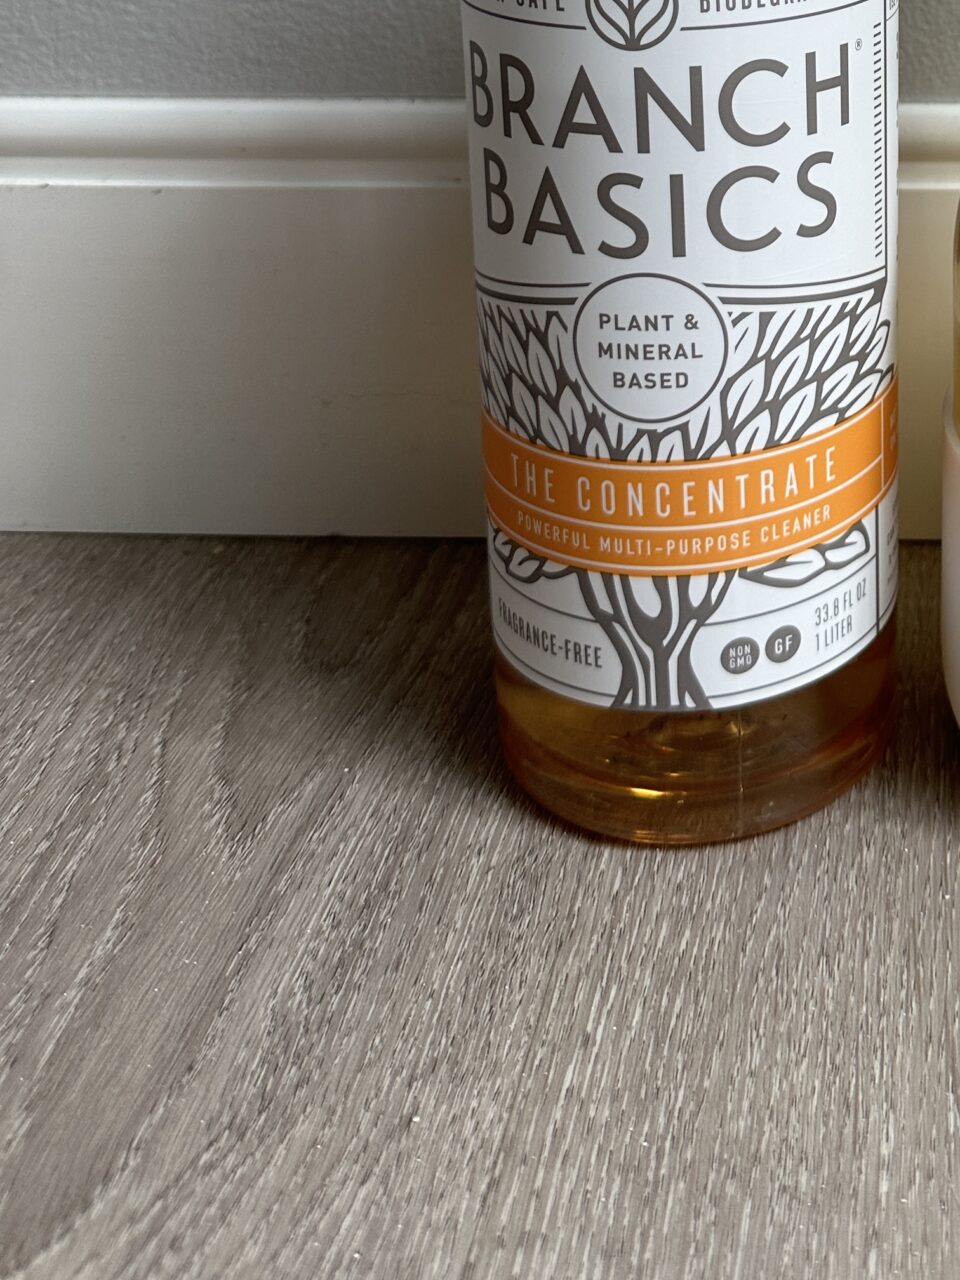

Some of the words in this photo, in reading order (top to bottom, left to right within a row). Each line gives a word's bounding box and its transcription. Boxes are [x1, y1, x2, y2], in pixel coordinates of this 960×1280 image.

[483, 147, 838, 260] BASICS
[599, 313, 674, 331] PLANT
[684, 313, 700, 330] &
[598, 341, 704, 360] MINERAL
[612, 371, 690, 389] BASED
[511, 453, 555, 503] THE
[577, 445, 837, 518] CONCENTRATE
[518, 511, 591, 550] POWERFUL
[600, 530, 751, 556] MULTI-PURPOSE
[760, 504, 831, 543] CLEANER
[814, 598, 840, 627] 33.8
[843, 588, 853, 612] FL
[856, 577, 867, 602] OZ
[824, 614, 853, 648] LITER
[729, 643, 751, 658] NON
[774, 634, 793, 655] GF
[729, 655, 752, 669] GMO
